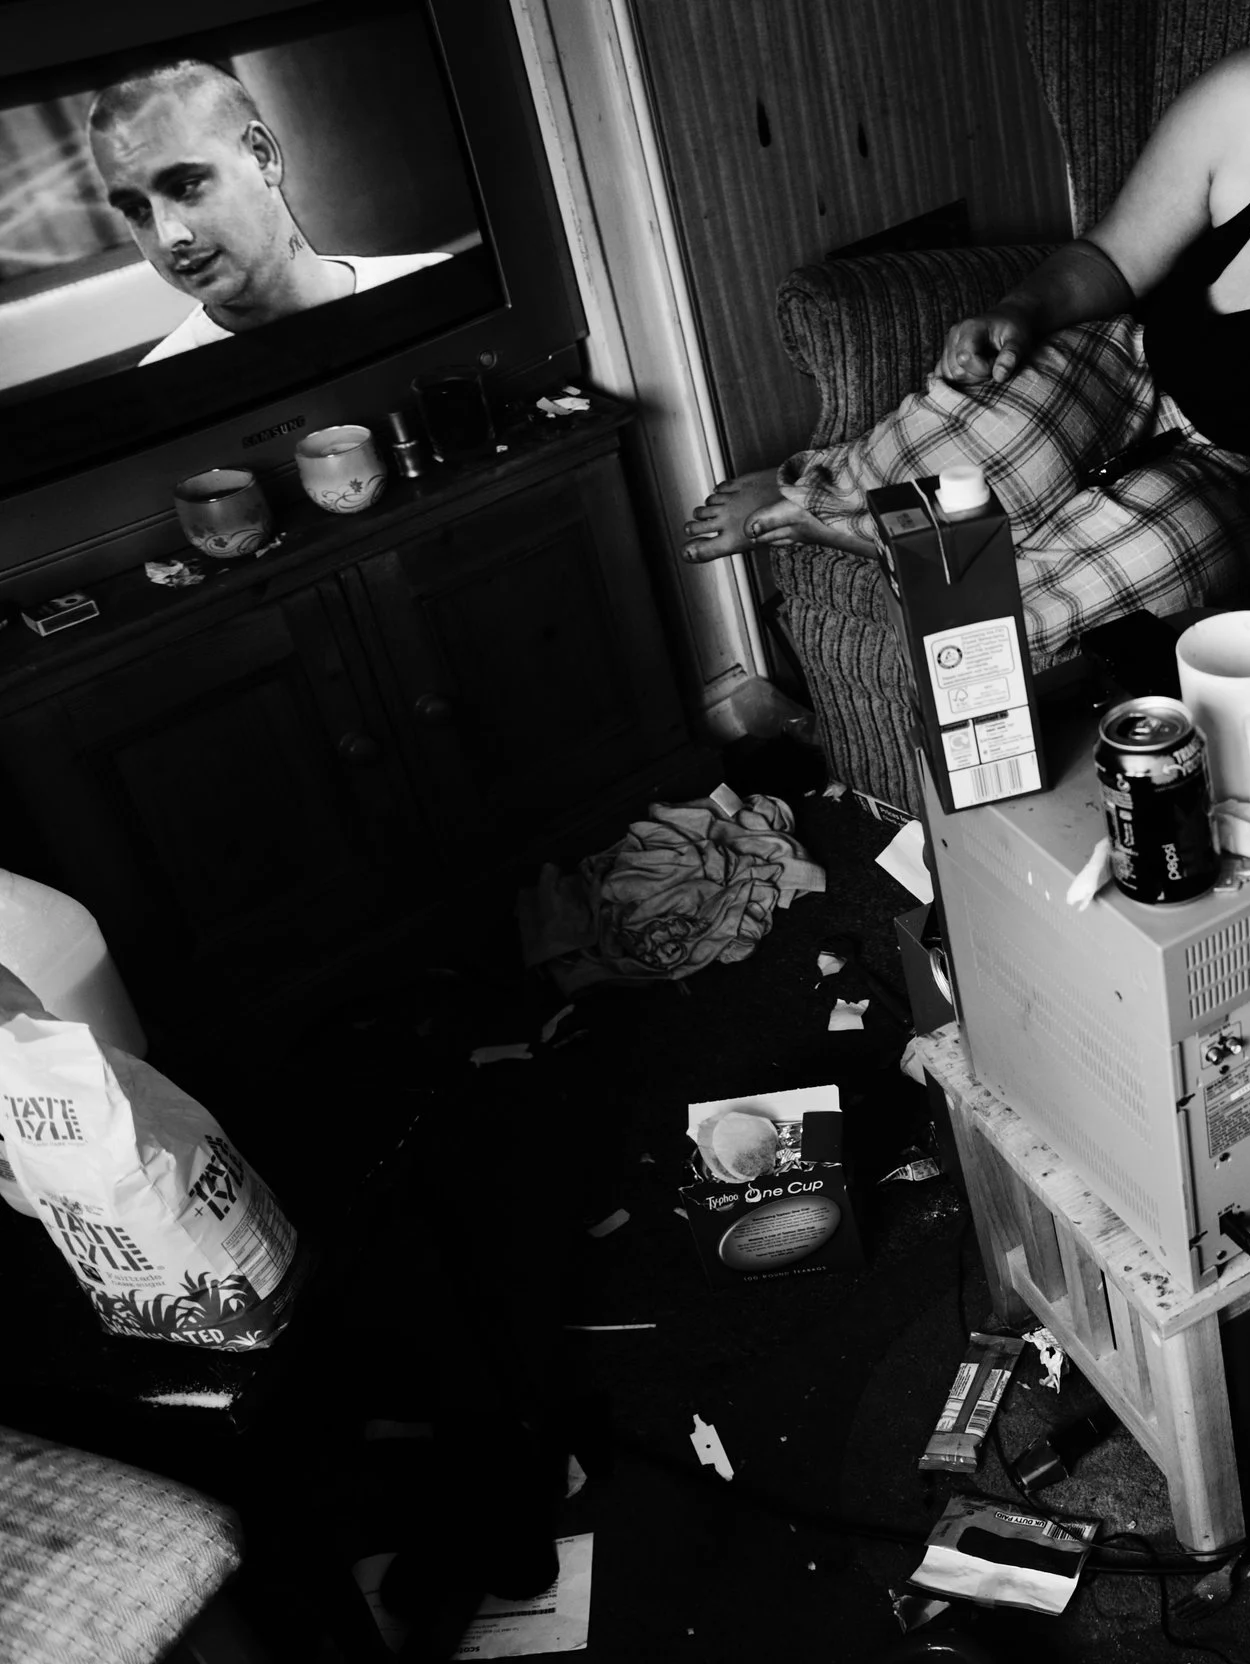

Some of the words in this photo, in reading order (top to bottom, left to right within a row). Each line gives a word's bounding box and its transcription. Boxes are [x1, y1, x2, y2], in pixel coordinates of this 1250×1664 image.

[242, 415, 305, 449] SAMSUNG
[4, 1095, 77, 1119] TATE
[15, 1119, 83, 1141] LYLE
[745, 1182, 783, 1203] One
[787, 1180, 824, 1194] Cup
[39, 1198, 137, 1249] TATE
[60, 1230, 154, 1271] LYLE
[997, 1512, 1013, 1522] PAID
[1014, 1517, 1033, 1525] DUTY
[1035, 1520, 1045, 1528] UK
